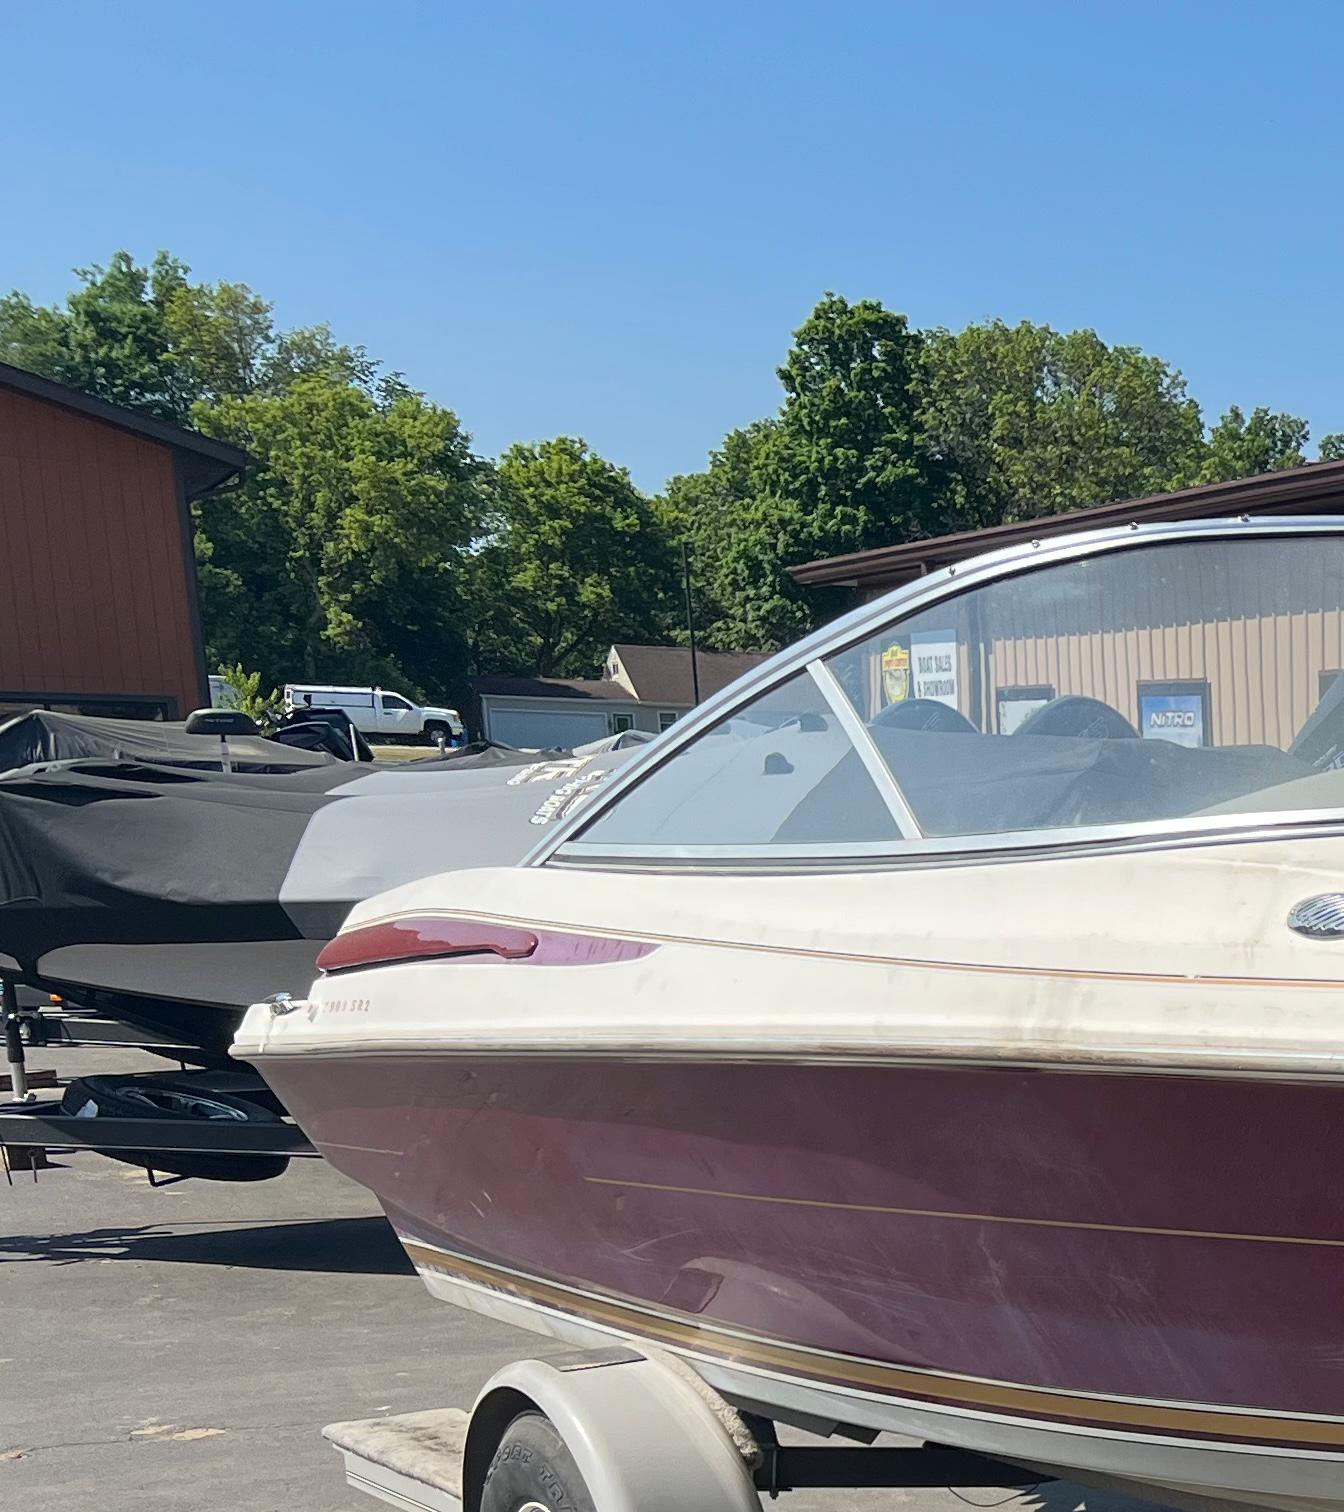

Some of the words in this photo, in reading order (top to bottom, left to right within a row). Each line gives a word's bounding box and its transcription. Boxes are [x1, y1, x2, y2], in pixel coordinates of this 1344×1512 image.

[918, 655, 934, 674] BOAT
[934, 654, 952, 673] SALES
[923, 679, 955, 697] SHOWROOM
